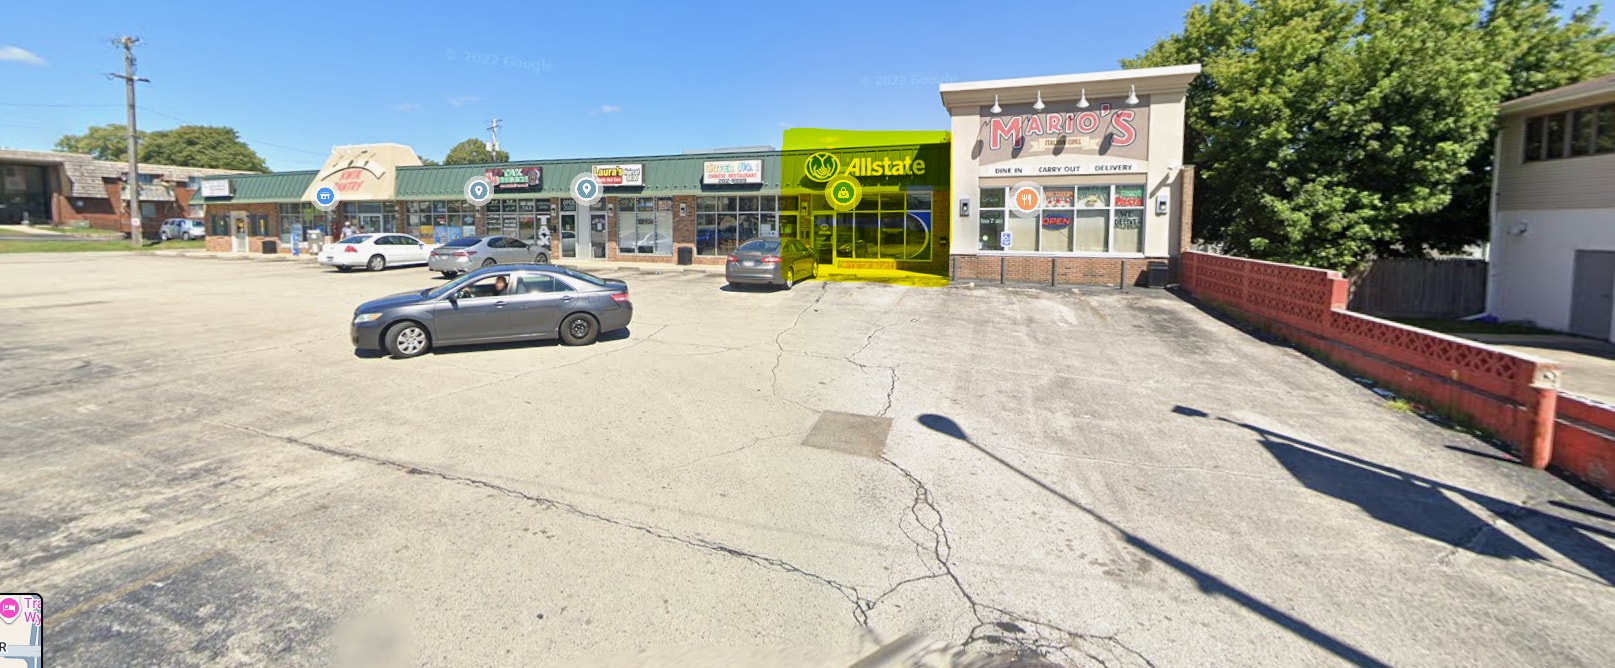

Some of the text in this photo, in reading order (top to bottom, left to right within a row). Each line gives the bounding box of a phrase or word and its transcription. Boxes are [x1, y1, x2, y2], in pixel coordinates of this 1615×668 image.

[989, 103, 1136, 150] MARIO'S
[502, 168, 522, 177] TAX
[593, 166, 624, 177] Laura's
[843, 156, 925, 176] Allstate
